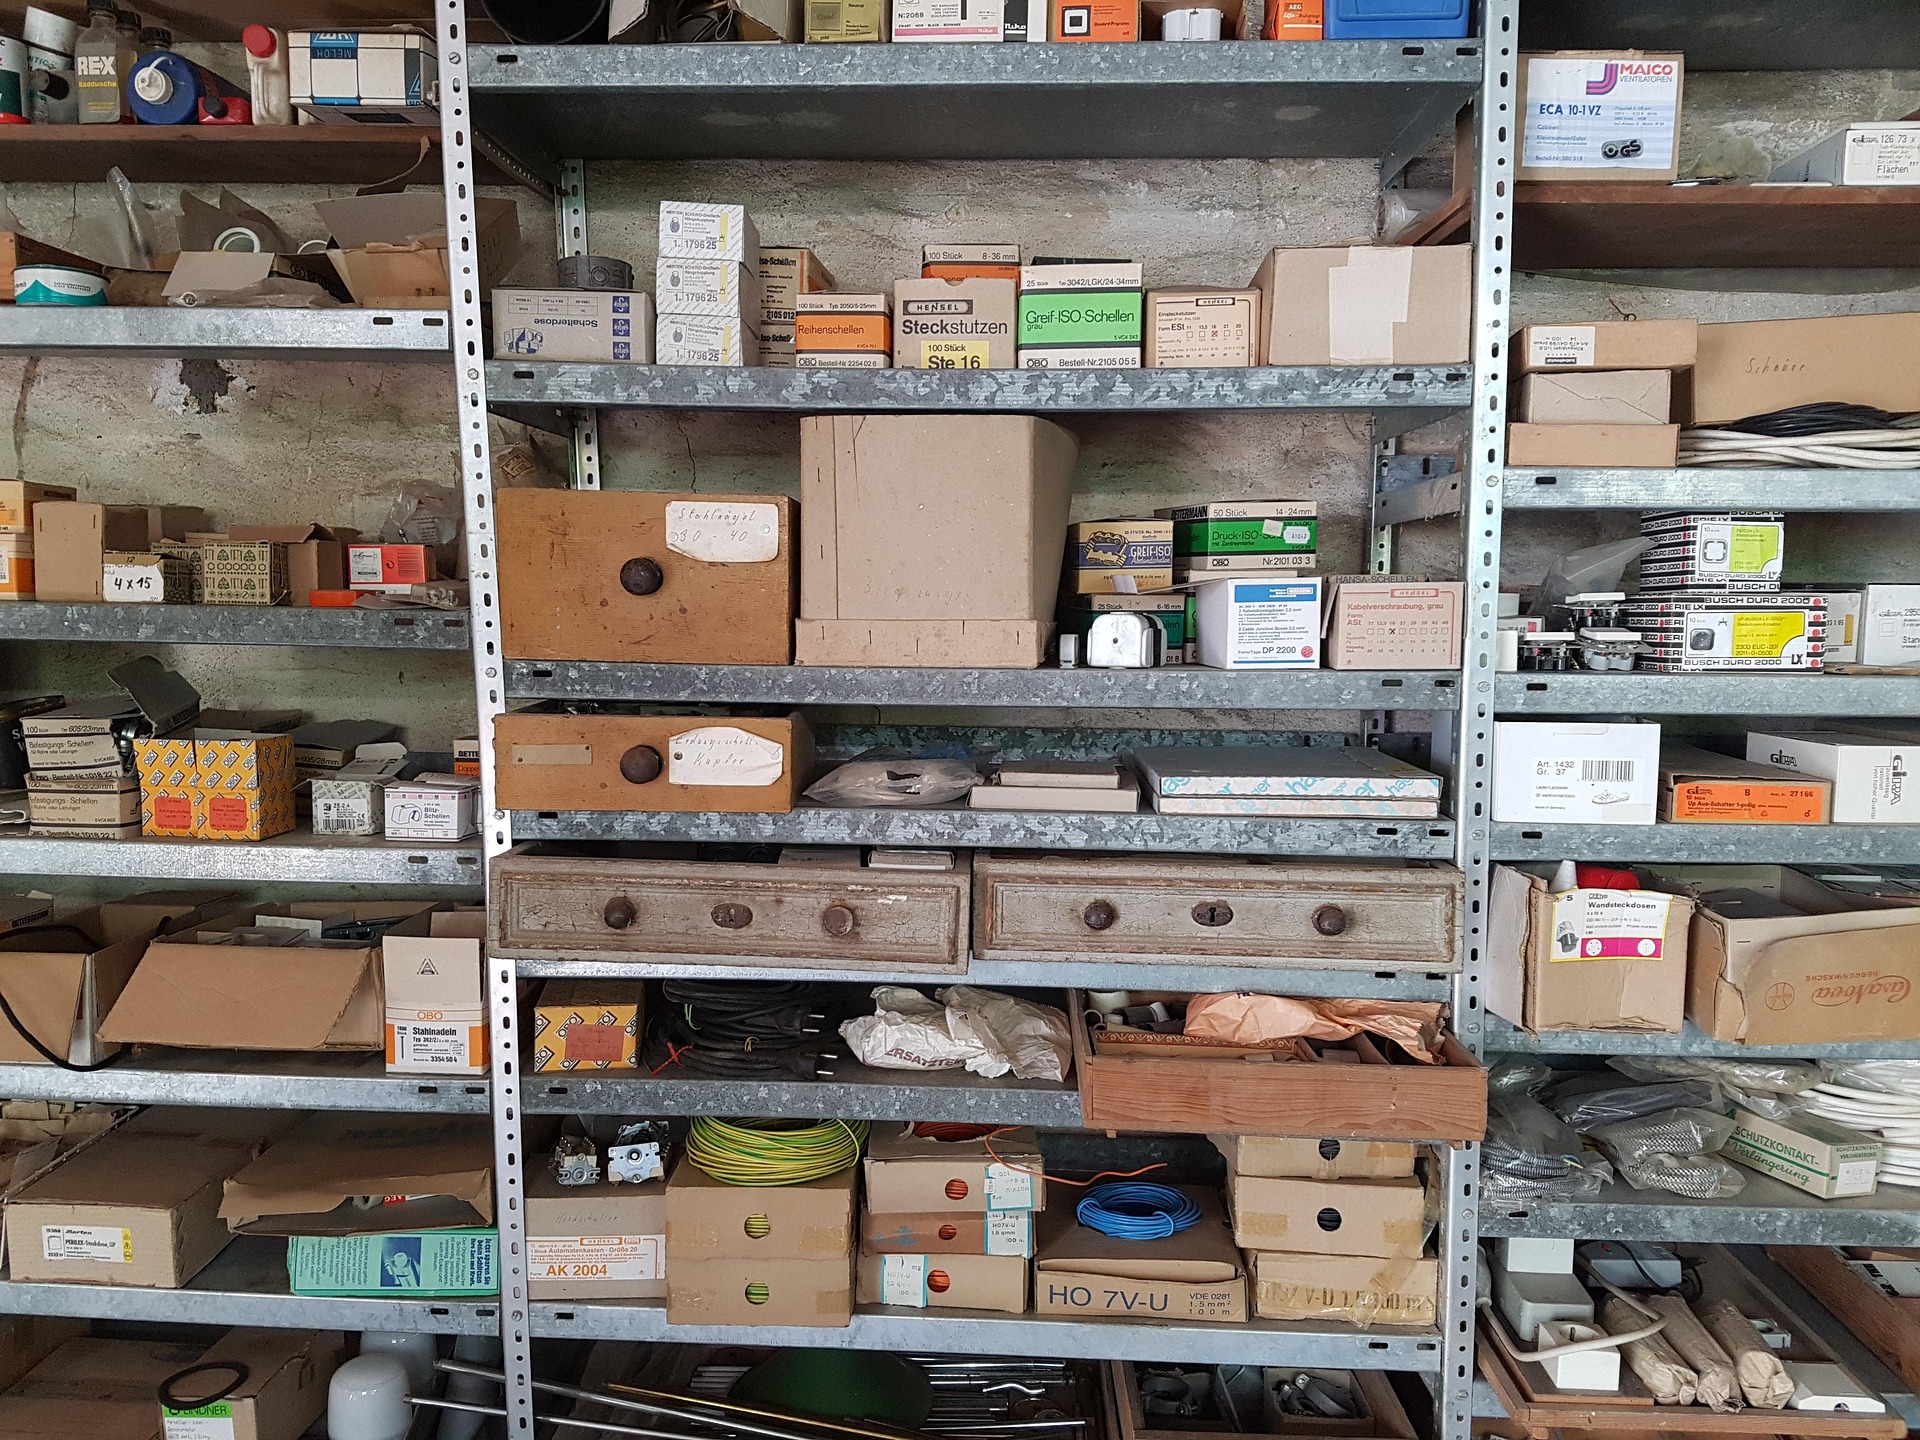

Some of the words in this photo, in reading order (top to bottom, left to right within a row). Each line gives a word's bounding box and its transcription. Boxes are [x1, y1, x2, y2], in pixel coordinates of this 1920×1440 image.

[316, 49, 352, 58] MELOH
[77, 56, 116, 76] REX
[1619, 63, 1674, 76] MAICO
[1619, 75, 1673, 83] VENTILATOREN
[1539, 103, 1563, 115] ECA
[1568, 104, 1586, 116] 10-1
[1588, 105, 1602, 116] VZ
[1881, 134, 1894, 144] 126
[1898, 134, 1907, 144] 73
[928, 251, 940, 260] 100
[942, 251, 963, 260] Stück
[1026, 279, 1036, 287] 25
[1066, 277, 1139, 287] 3042/LGK/24-34mm
[916, 302, 959, 313] HENSEL
[783, 310, 795, 320] 012
[1025, 309, 1135, 324] Greif-ISO-Schellen
[533, 318, 598, 328] Schalterdose
[901, 318, 1008, 335] Steckstutzen
[1026, 322, 1043, 331] grau
[797, 325, 864, 335] Reihenschellen
[928, 344, 942, 352] 100
[943, 343, 967, 352] Stück
[798, 357, 817, 366] OBO
[928, 355, 955, 369] Ste
[961, 355, 981, 369] 16
[1026, 357, 1048, 368] OBO
[1118, 357, 1130, 367] 05
[1213, 508, 1224, 517] 50
[1225, 508, 1248, 517] Stück
[1130, 545, 1171, 557] GREIF-ISO
[1211, 558, 1230, 567] OBO
[1292, 557, 1303, 566] 03
[1305, 556, 1311, 565] 3
[114, 577, 122, 591] 4
[136, 576, 153, 589] 15
[1728, 583, 1767, 591] BUSCH
[1347, 603, 1425, 611] Kabelverschraubung,
[1427, 603, 1444, 611] grau
[1346, 618, 1362, 626] ASt
[1262, 646, 1274, 654] DP
[1276, 646, 1297, 654] 2200
[1791, 653, 1804, 665] LX
[26, 726, 38, 734] 100
[68, 725, 106, 733] 605/23mm
[1536, 760, 1552, 768] Art.
[1554, 760, 1575, 768] 1432
[1536, 768, 1550, 776] Gr.
[1555, 768, 1566, 776] 37
[424, 812, 451, 820] Schellen
[1588, 901, 1657, 910] Wandsteckdosen
[1805, 970, 1879, 982] HERRENWÄSCHE
[417, 1011, 443, 1020] OBO
[412, 1026, 457, 1036] Stahlnadeln
[1734, 1126, 1819, 1166] SCHUTZKONTAKT-
[1731, 1141, 1811, 1185] Verlängerung
[484, 1238, 492, 1253] Jetzt
[476, 1256, 484, 1283] Schlitzen
[546, 1264, 568, 1277] AK
[572, 1264, 608, 1276] 2004
[1103, 1289, 1169, 1312] 7V-U
[1189, 1292, 1209, 1300] VDE
[1210, 1292, 1231, 1301] 0281
